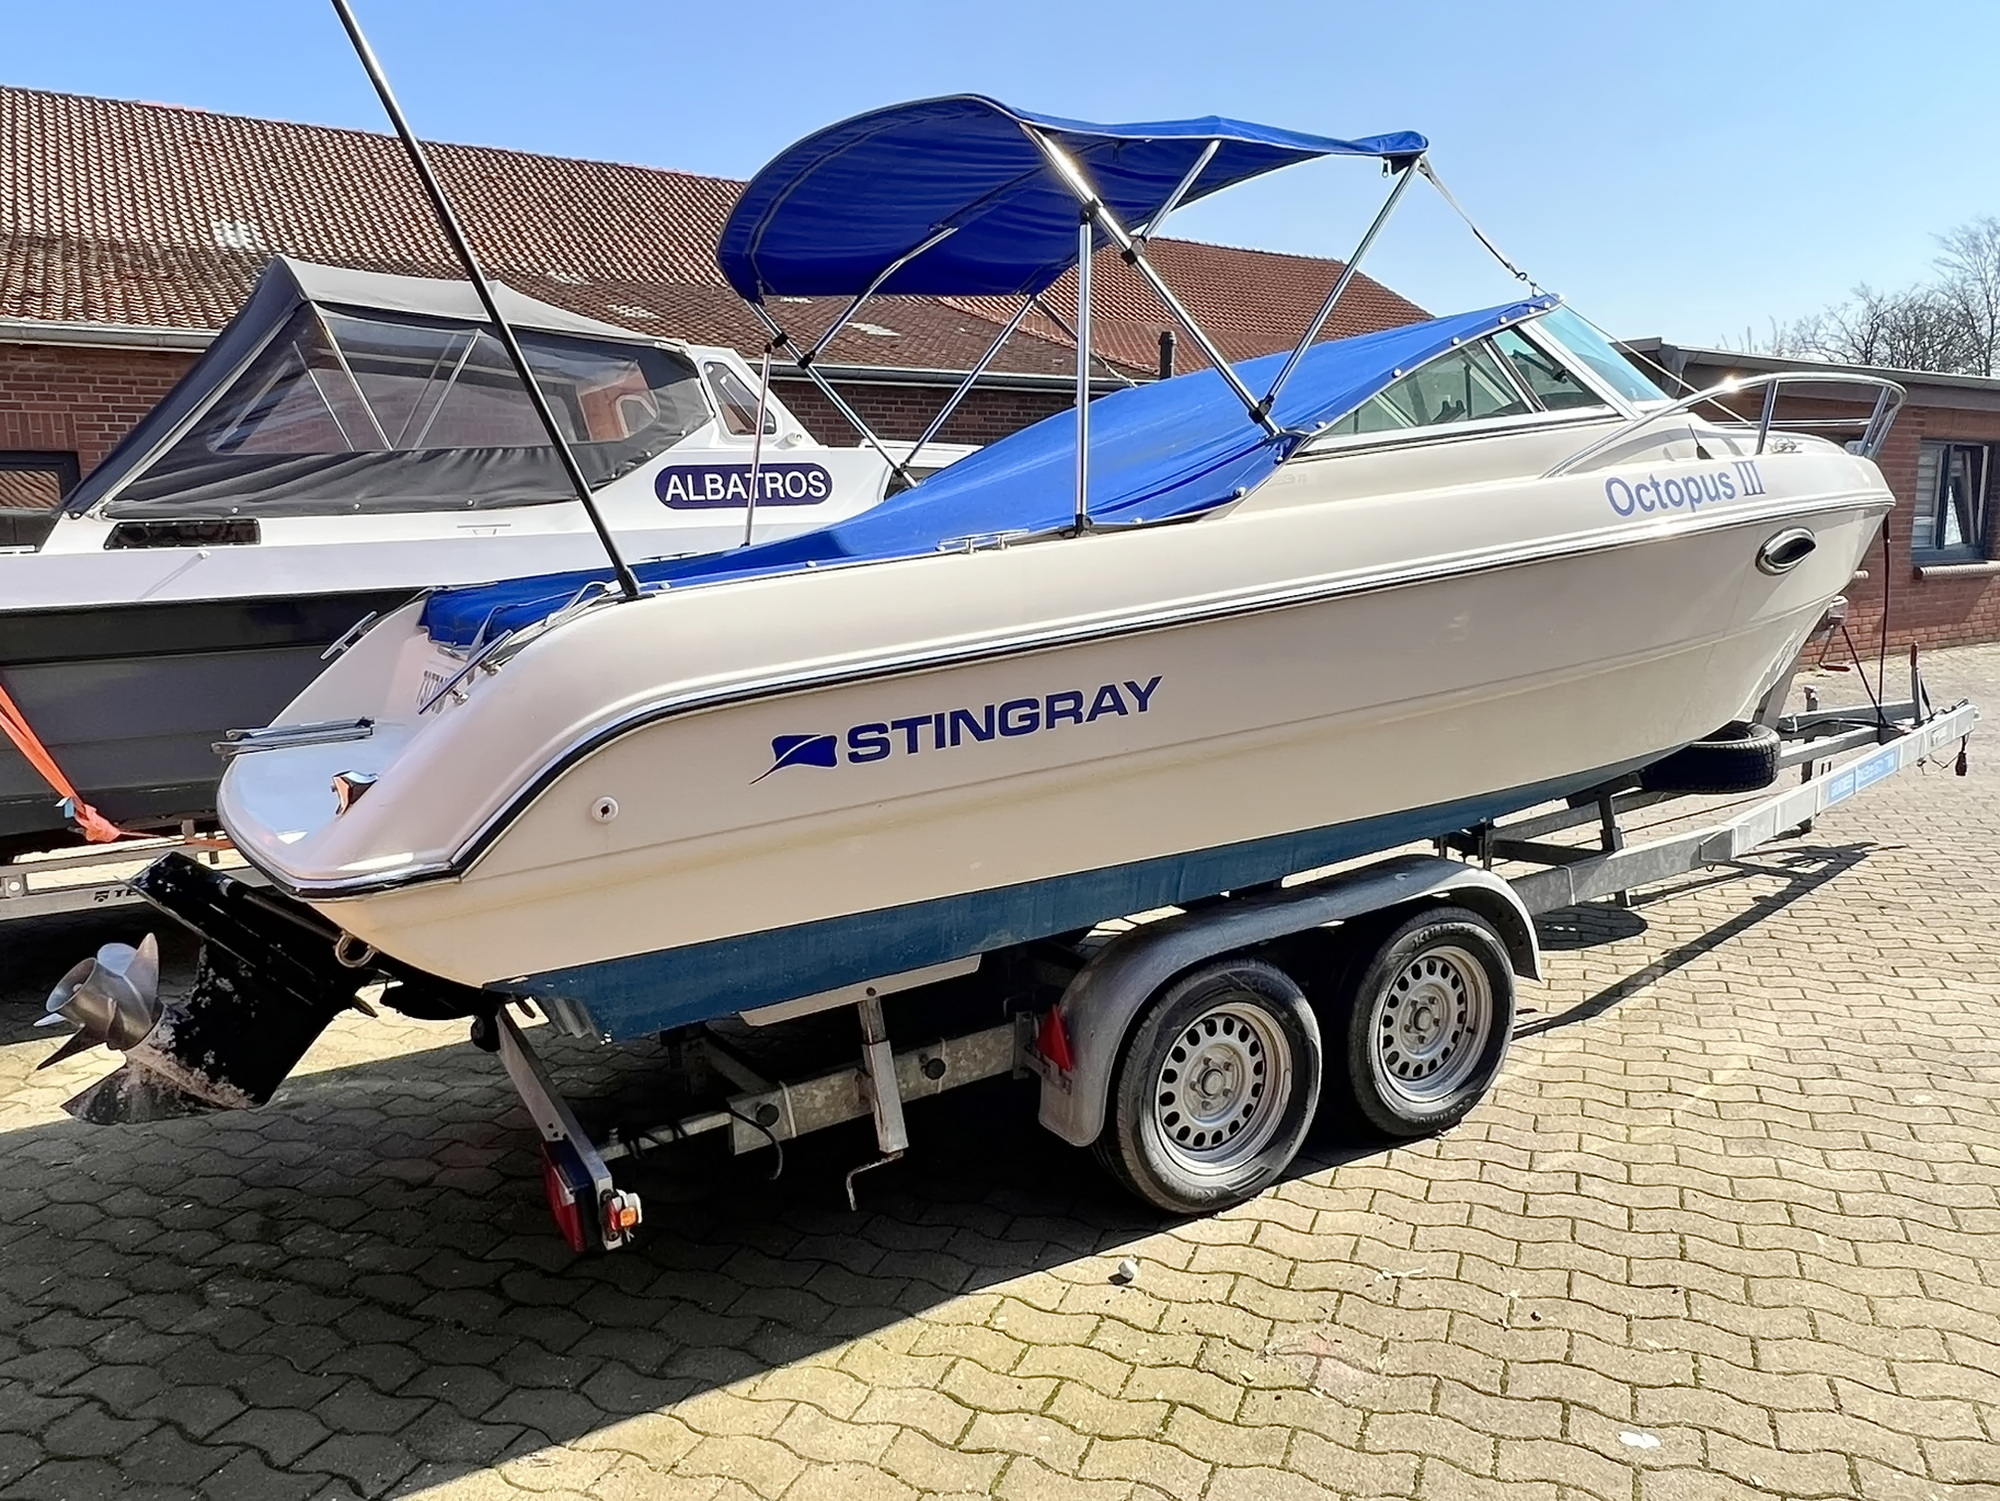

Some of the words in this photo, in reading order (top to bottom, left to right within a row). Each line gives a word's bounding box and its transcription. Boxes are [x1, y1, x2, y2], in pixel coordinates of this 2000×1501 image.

[665, 470, 827, 502] ALBATROS
[1605, 472, 1736, 516] Octopus
[1731, 460, 1766, 496] III
[847, 675, 1163, 764] STINGRAY
